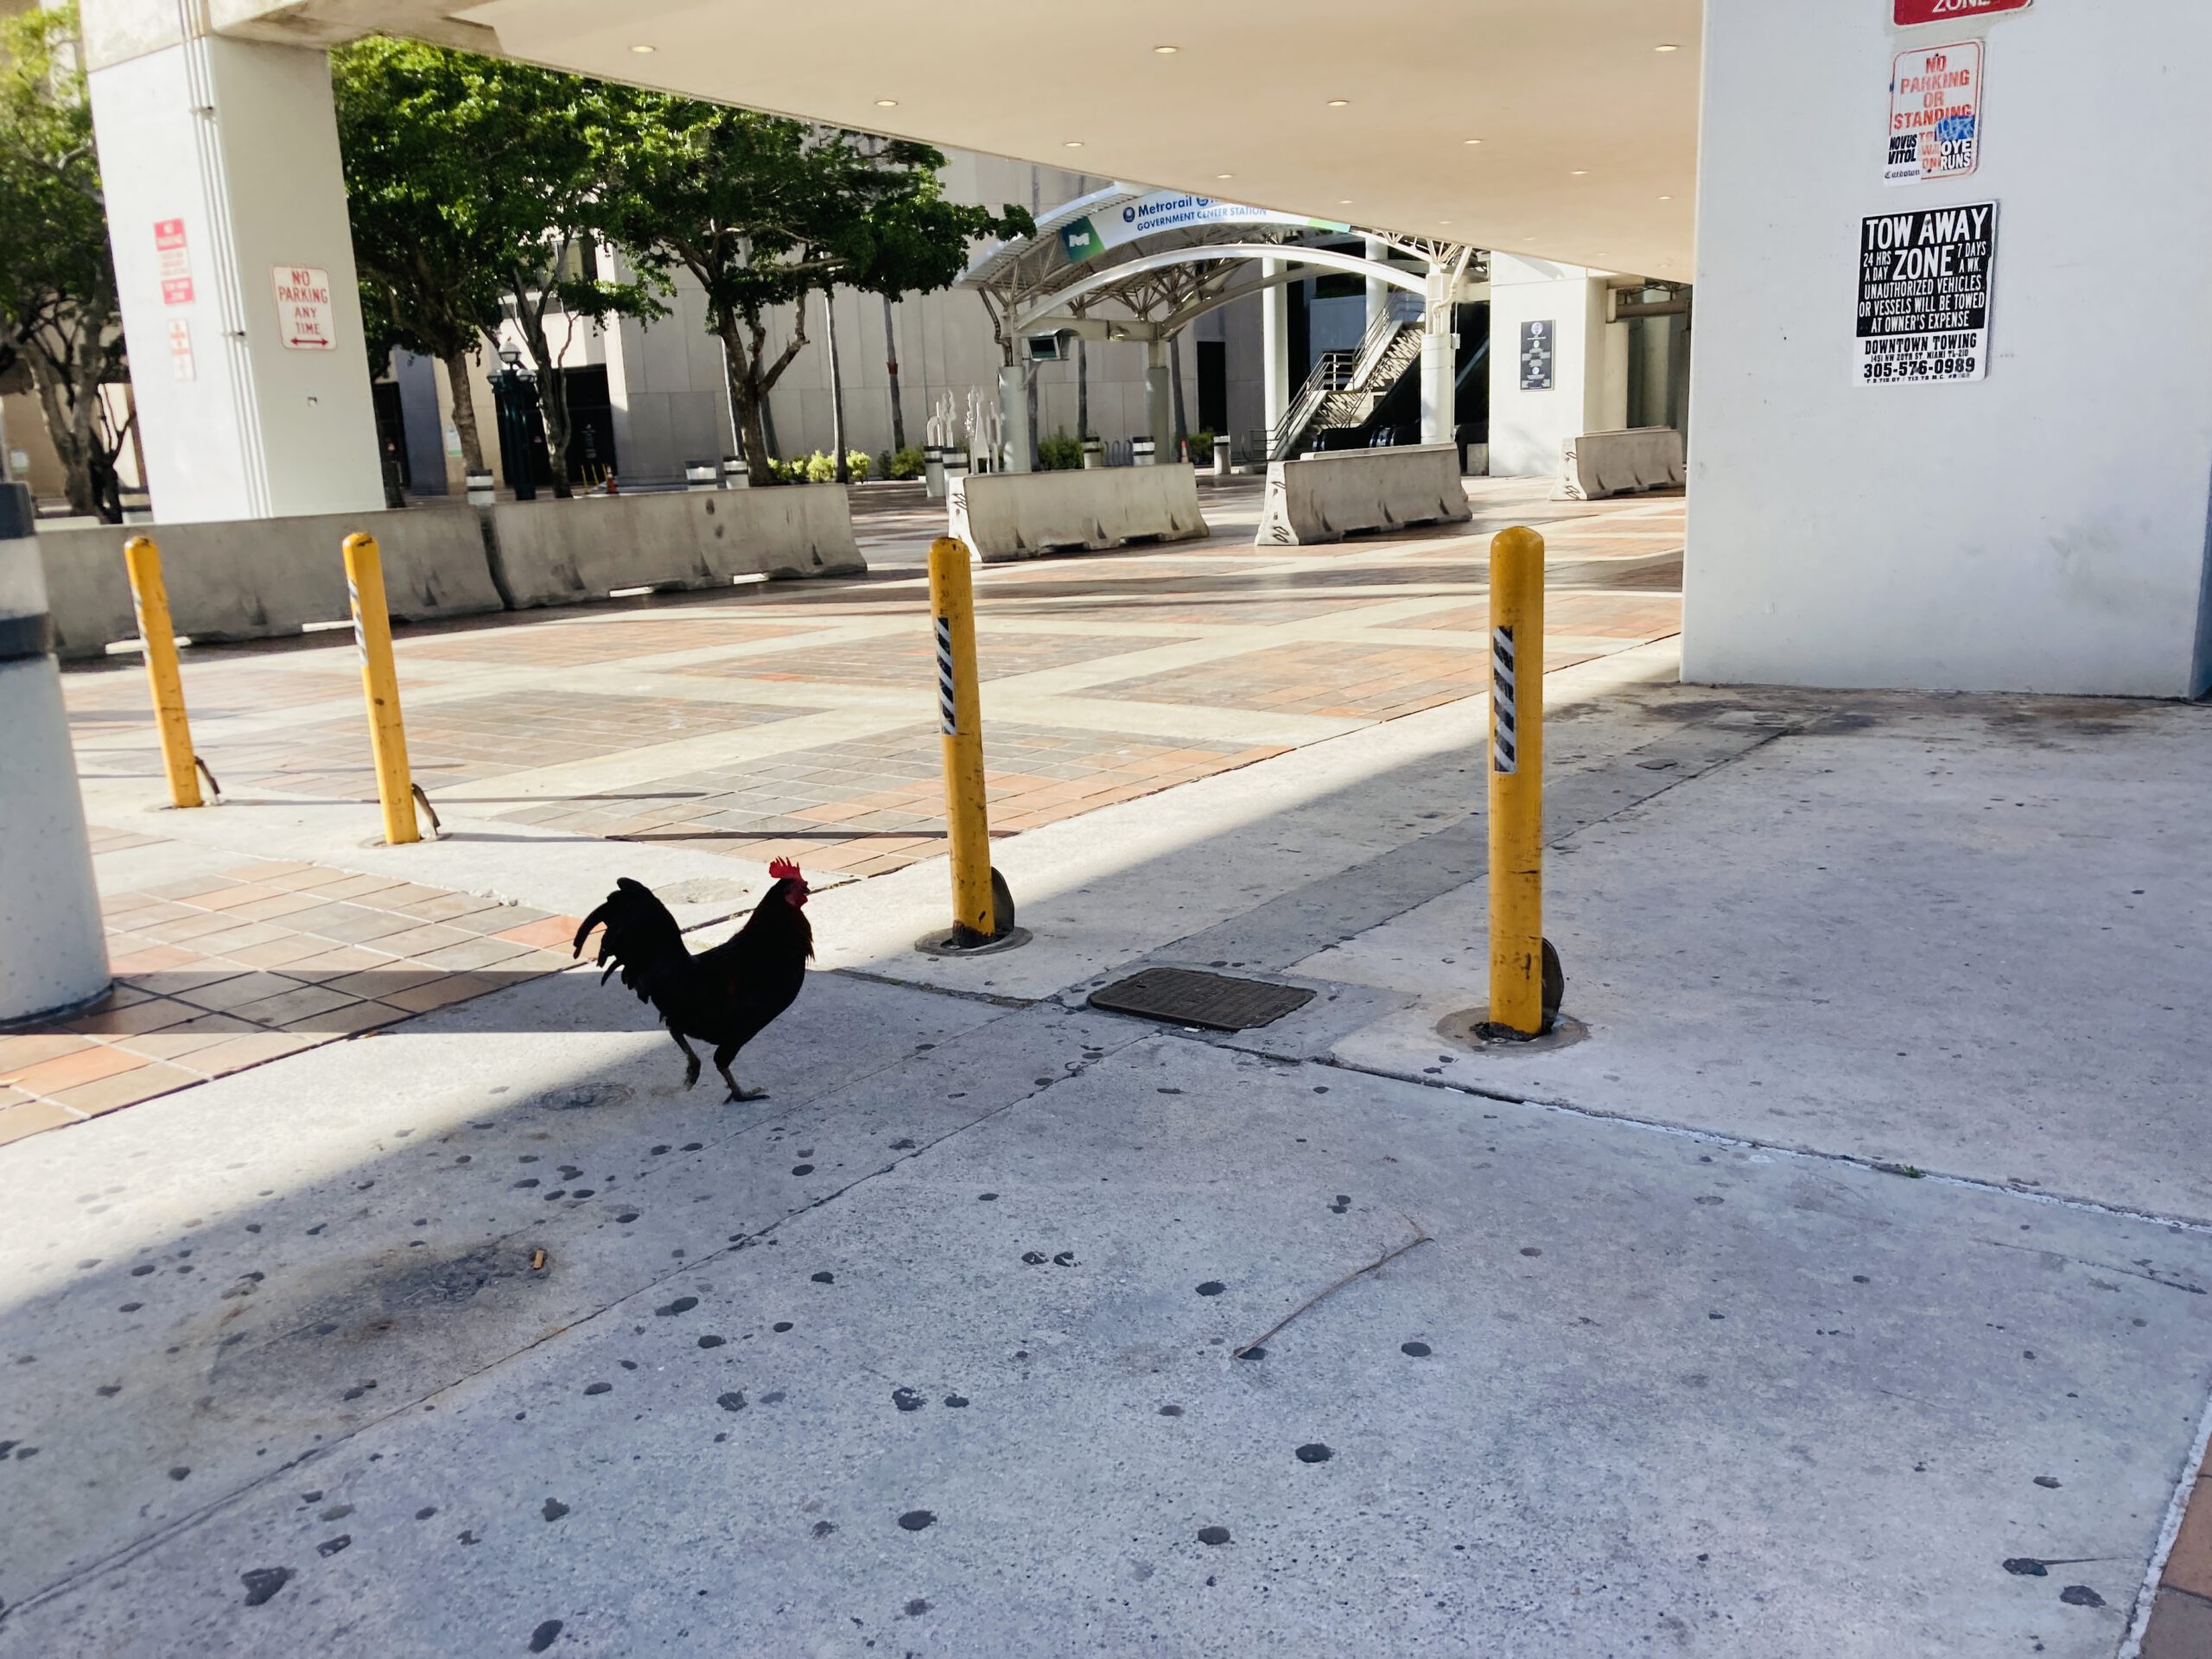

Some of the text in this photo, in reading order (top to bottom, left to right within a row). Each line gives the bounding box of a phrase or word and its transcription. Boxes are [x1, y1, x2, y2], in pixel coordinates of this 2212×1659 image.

[1932, 0, 1991, 13] ZO
[1925, 55, 1947, 74] NO
[1900, 69, 1970, 94] PARKING
[1923, 91, 1944, 109] OR
[1893, 104, 1972, 130] STANDING
[1889, 133, 1917, 150] NOVUS
[1941, 138, 1972, 156] OYE
[1887, 149, 1916, 165] VITOL
[1941, 152, 1971, 171] RUNS
[1138, 194, 1192, 217] Metrorail
[1137, 207, 1268, 232] GOVERNMENT CENTER STATION
[1866, 207, 1988, 250] TOW AWAY
[1957, 241, 1986, 258] 7 DAYS
[1863, 251, 1891, 268] 24 HRS
[1892, 245, 1955, 281] ZONE
[1959, 258, 1965, 273] A
[291, 270, 310, 286] NO
[1865, 266, 1889, 282] A DAY
[278, 286, 328, 304] PARKING
[1865, 274, 1981, 301] UNAUTHORIZED VEHICLES
[295, 307, 317, 318] ANY
[1859, 292, 1985, 317] OR VESSELS WILL BE TOWED
[296, 322, 321, 334] TIME
[1871, 310, 1970, 334] AT OWNER'S EXPENSE
[1865, 333, 1977, 355] DOWNTOWN TOWING
[1915, 352, 1923, 360] ST
[1864, 357, 1975, 378] 305-576-0989
